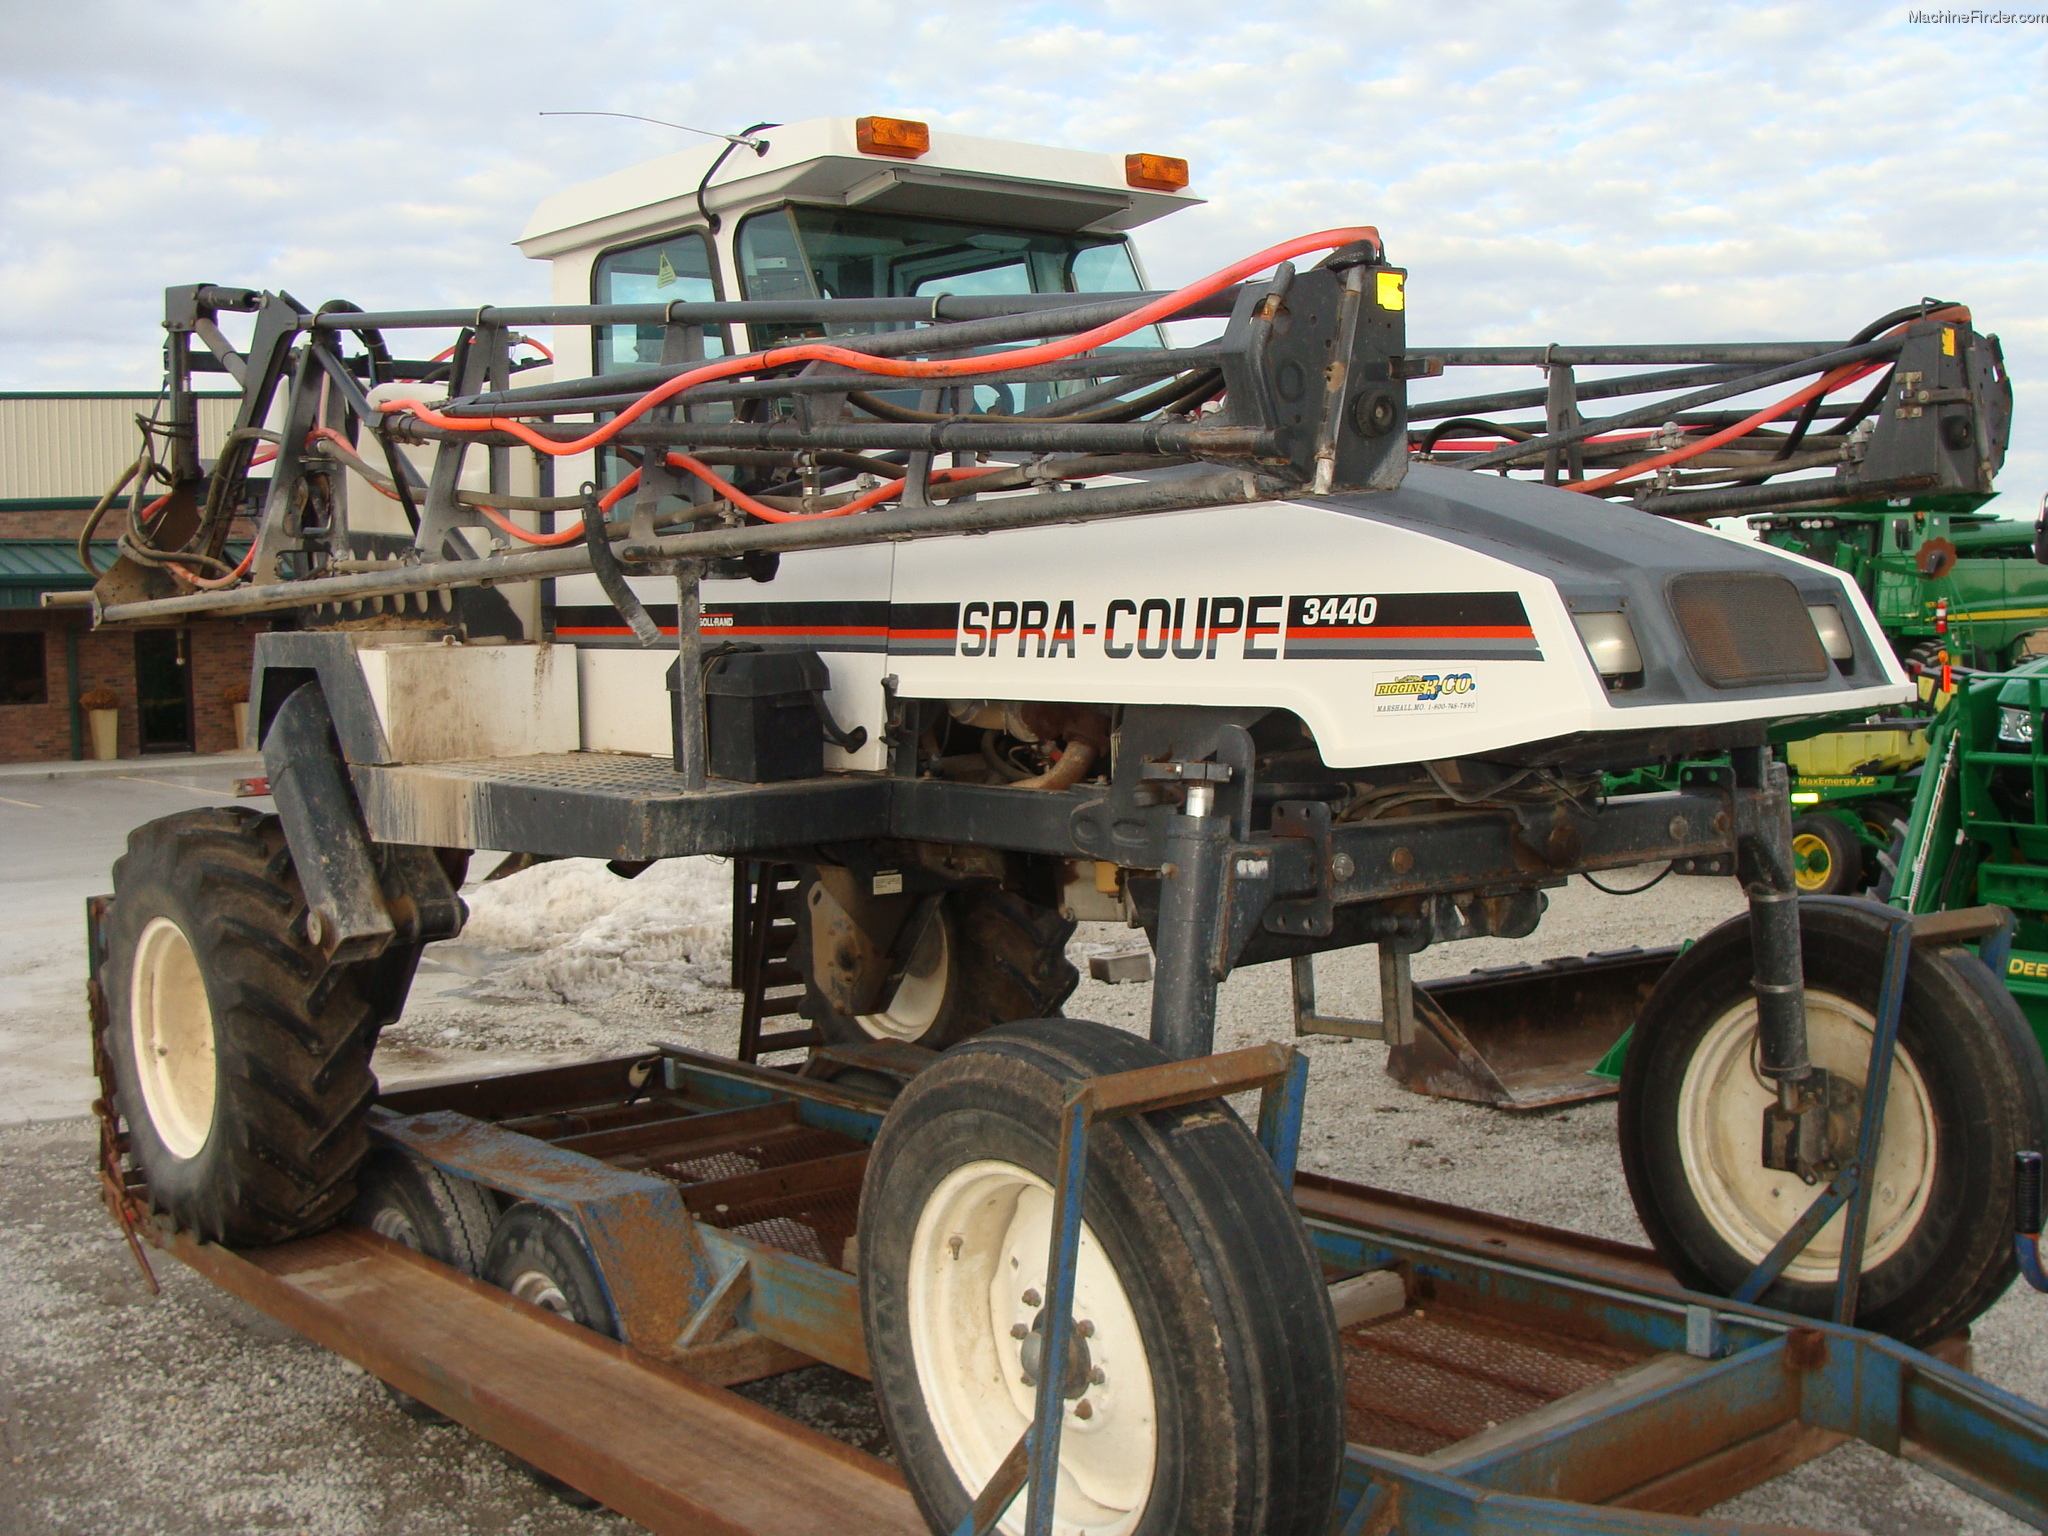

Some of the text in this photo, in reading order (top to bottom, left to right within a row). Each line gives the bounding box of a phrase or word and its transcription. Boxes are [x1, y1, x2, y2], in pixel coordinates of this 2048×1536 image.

[960, 595, 1377, 660] SPRA-COUPE 3440
[1378, 683, 1426, 694] RIGGINS
[1857, 776, 1876, 787] XP
